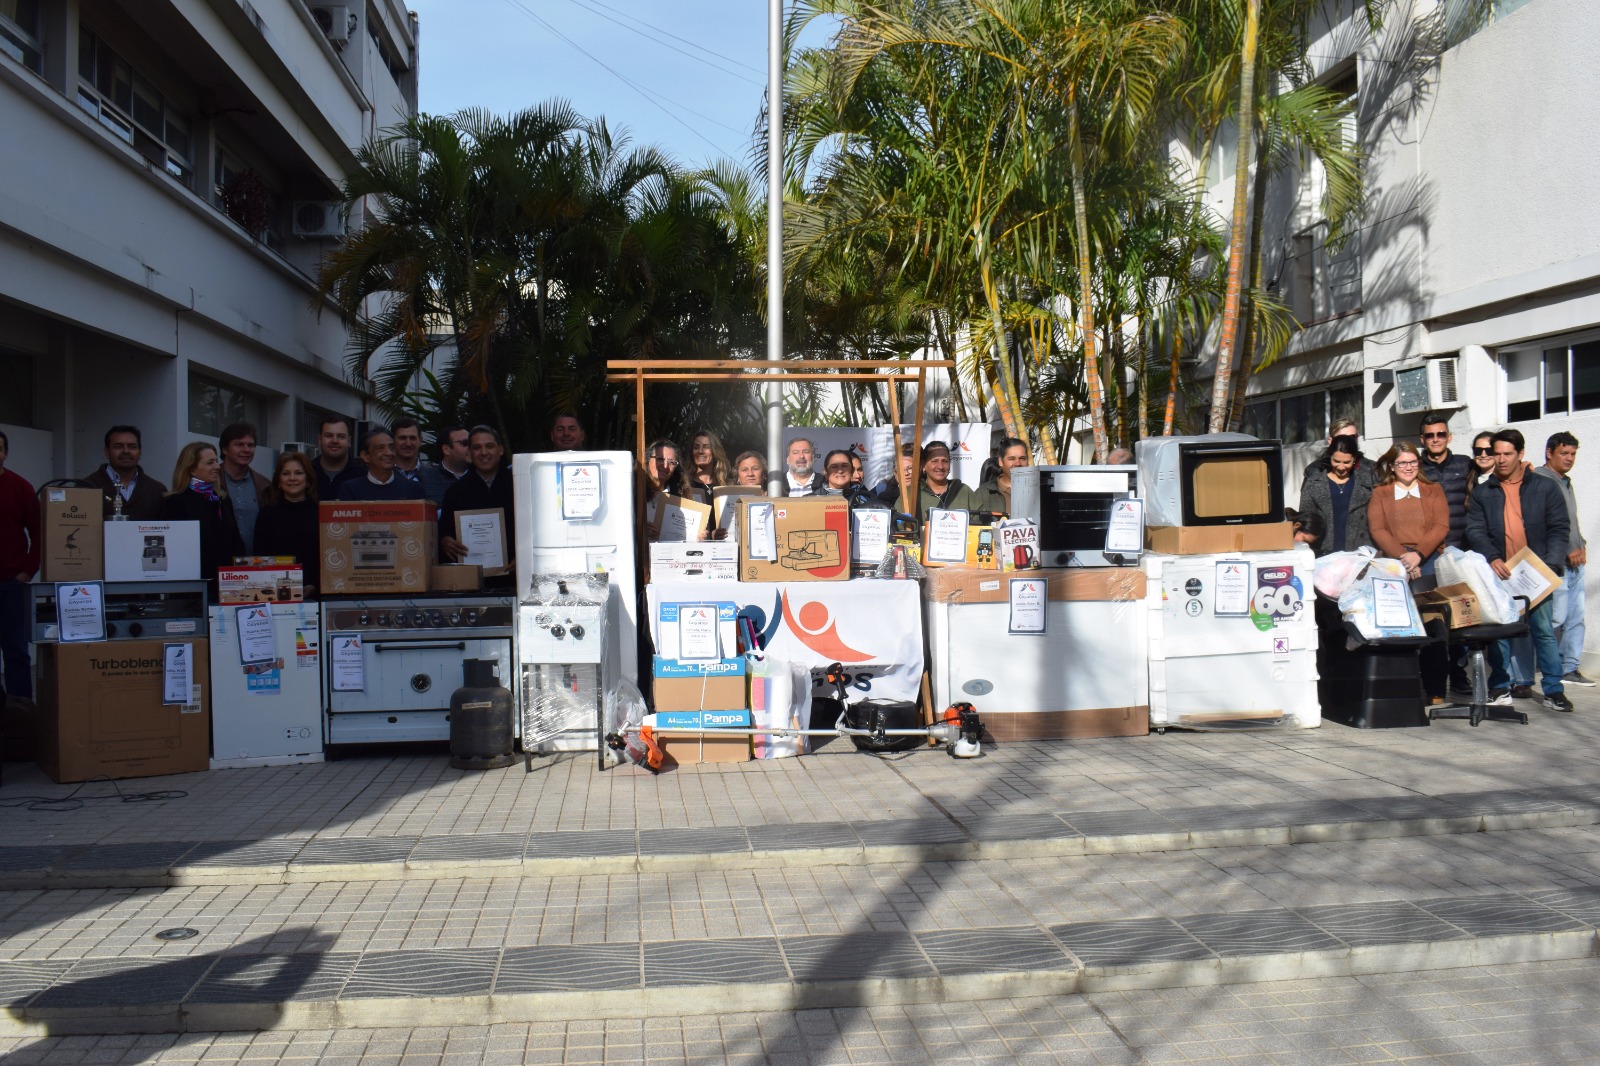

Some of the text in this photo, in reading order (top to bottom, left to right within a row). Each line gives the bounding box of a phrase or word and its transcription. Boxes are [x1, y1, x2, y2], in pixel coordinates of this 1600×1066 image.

[1003, 528, 1036, 540] PAVA
[221, 572, 249, 581] Liliana
[1253, 584, 1297, 616] 60
[1191, 602, 1198, 610] 5
[699, 663, 738, 673] Pampa
[704, 714, 744, 724] Pampa
